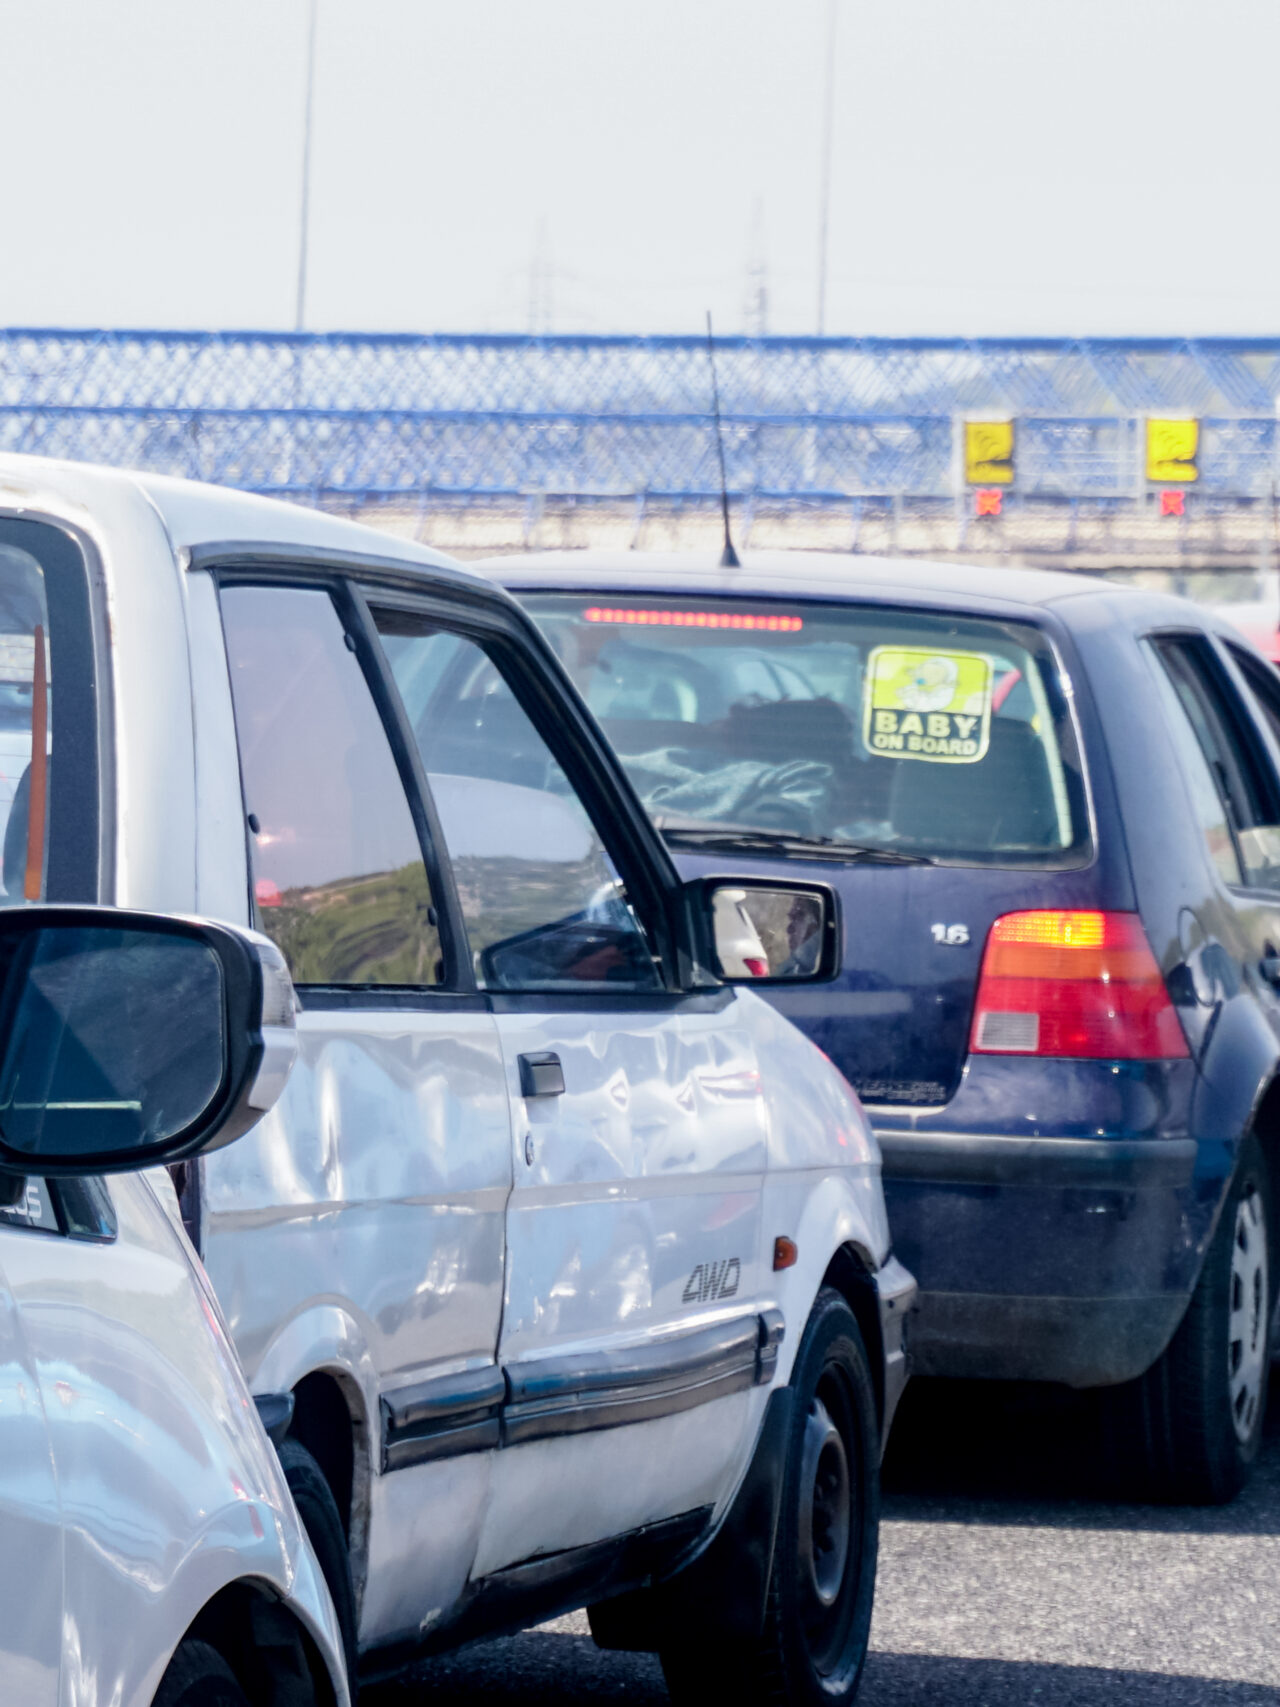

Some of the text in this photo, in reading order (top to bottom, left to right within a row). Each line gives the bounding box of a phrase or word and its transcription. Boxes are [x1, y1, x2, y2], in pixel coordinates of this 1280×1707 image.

[875, 710, 978, 739] BABY
[873, 732, 977, 756] ON BOARD
